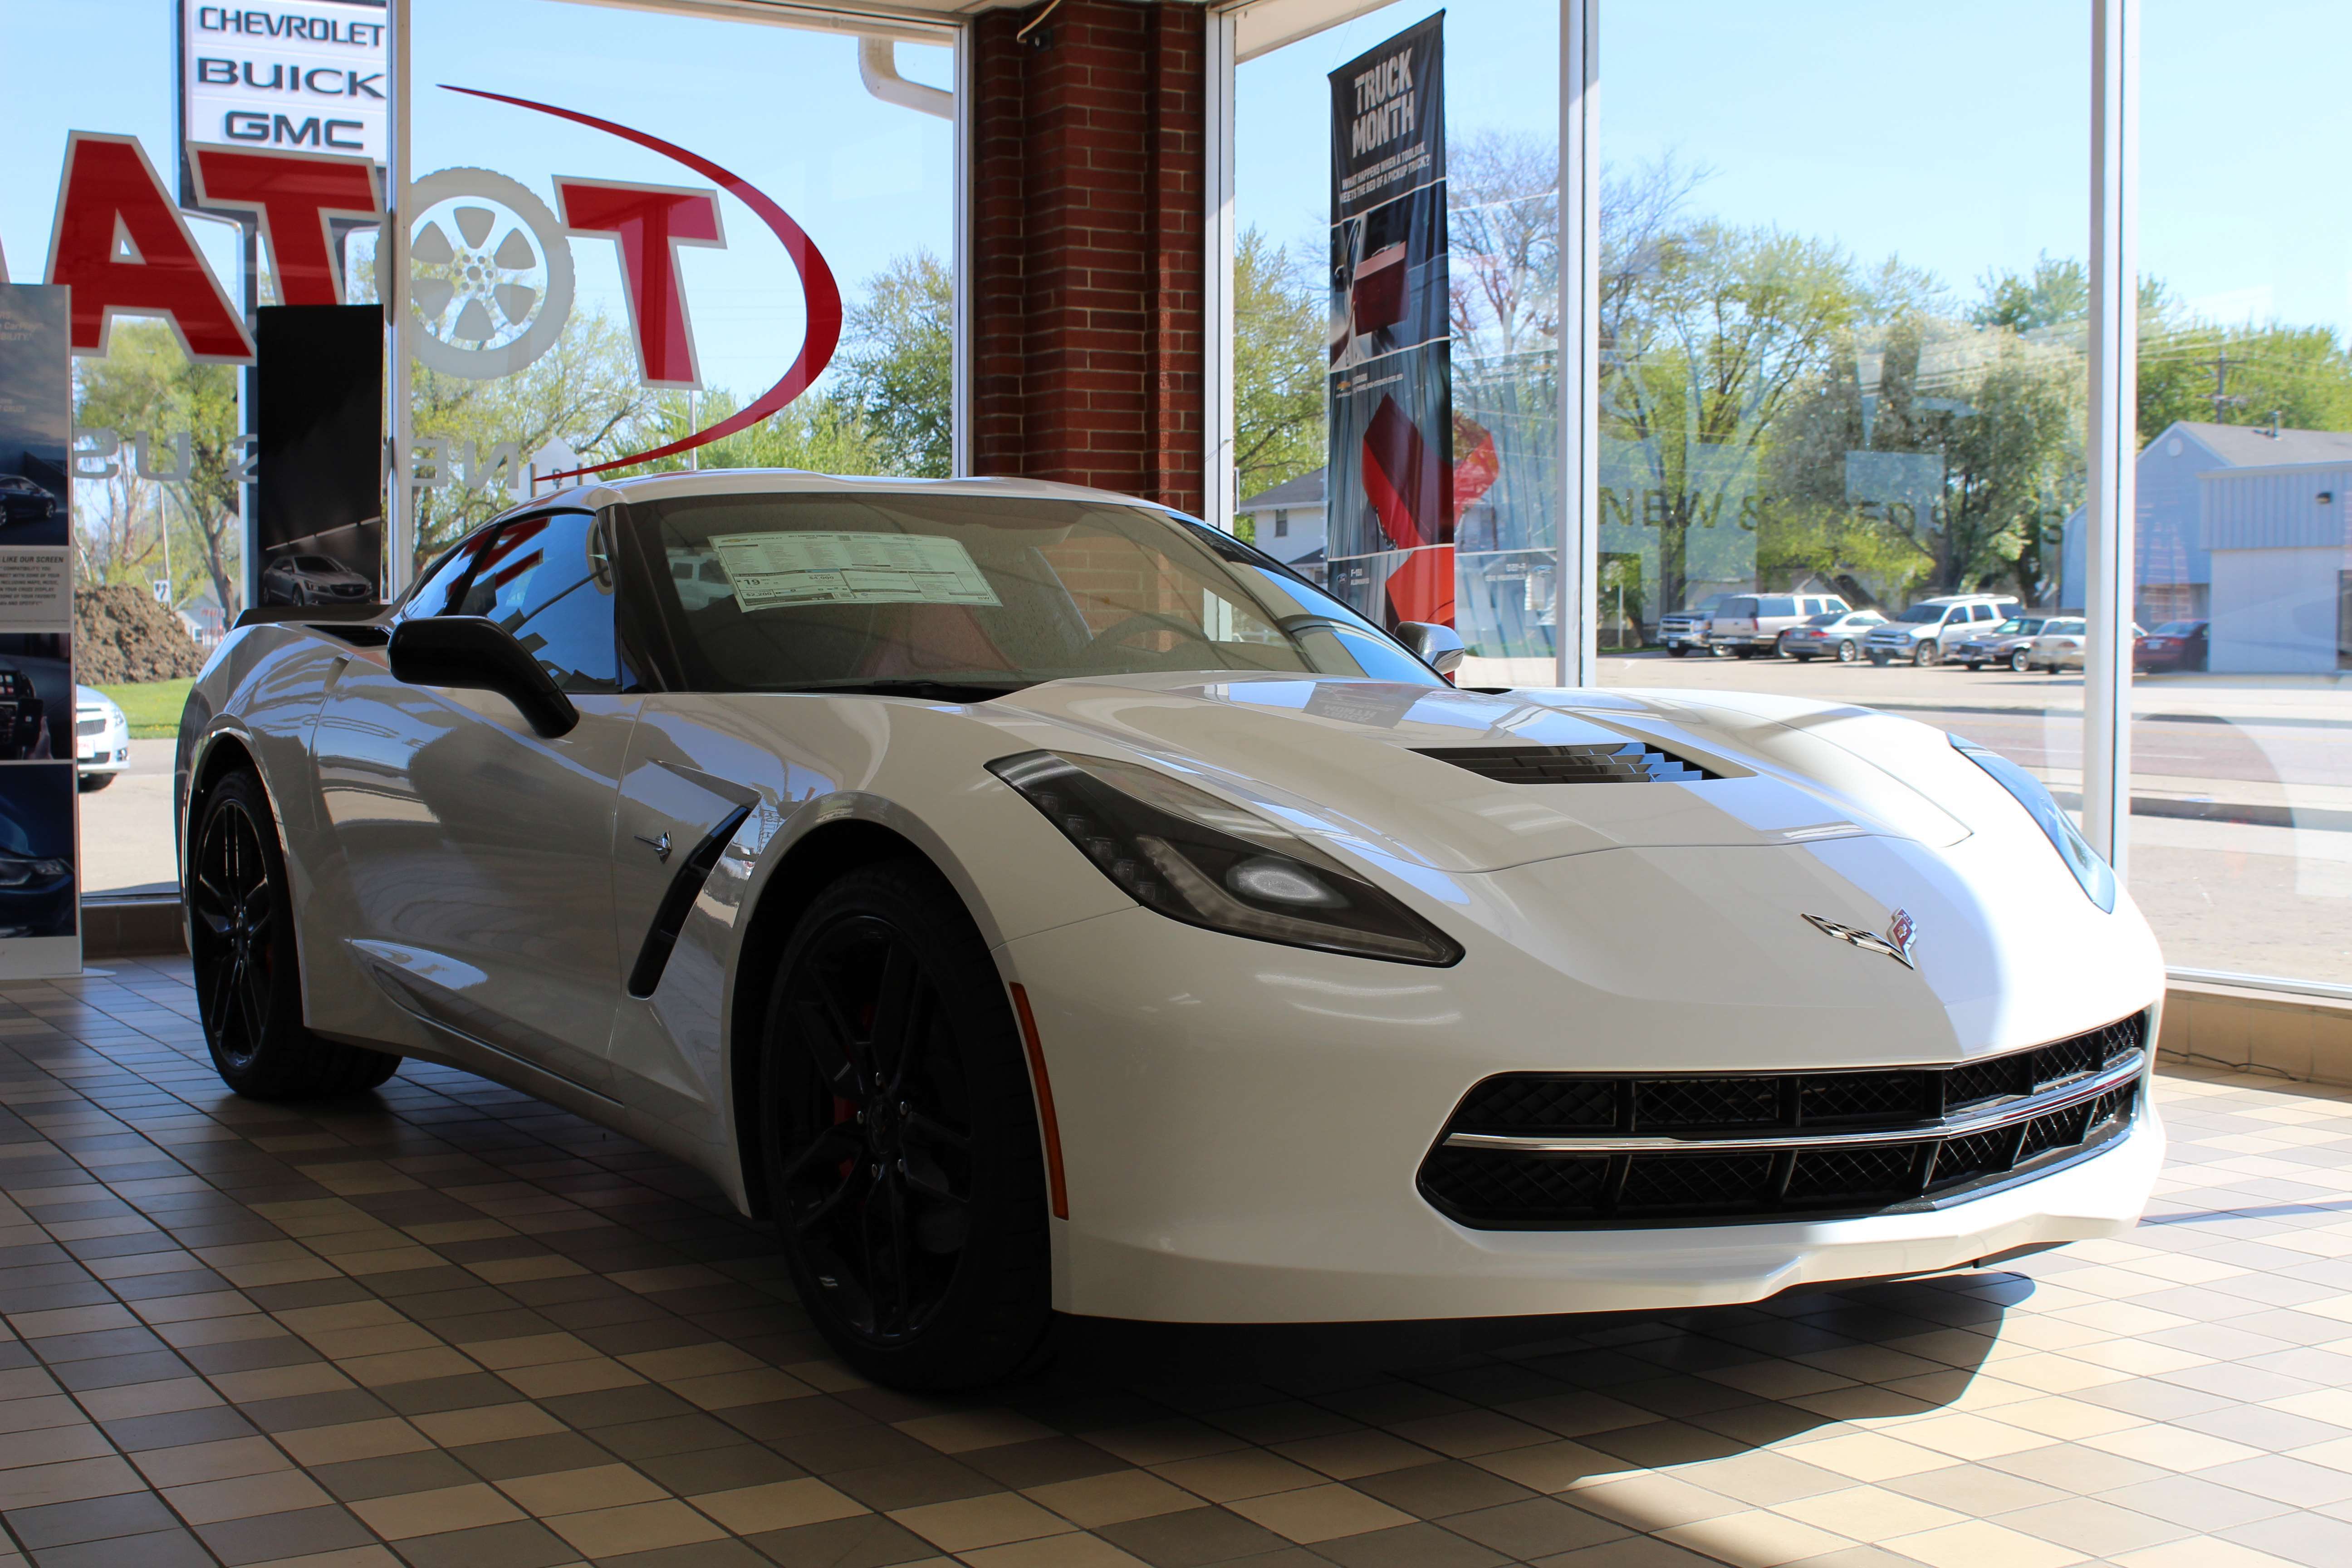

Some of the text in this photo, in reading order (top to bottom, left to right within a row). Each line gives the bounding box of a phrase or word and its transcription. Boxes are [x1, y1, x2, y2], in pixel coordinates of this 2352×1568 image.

[200, 6, 385, 48] CHEVROLET
[197, 57, 387, 99] BUICK
[1354, 47, 1414, 115] TRUCK
[225, 110, 364, 150] GMC
[1352, 90, 1415, 159] MONTH
[1339, 154, 1431, 203] MEETS THE BED OF A PICKUP TRUCK?
[1342, 174, 1357, 190] WHAT
[1357, 163, 1380, 183] HAPPENS
[1380, 155, 1396, 173] WHEN
[1396, 153, 1401, 166] A
